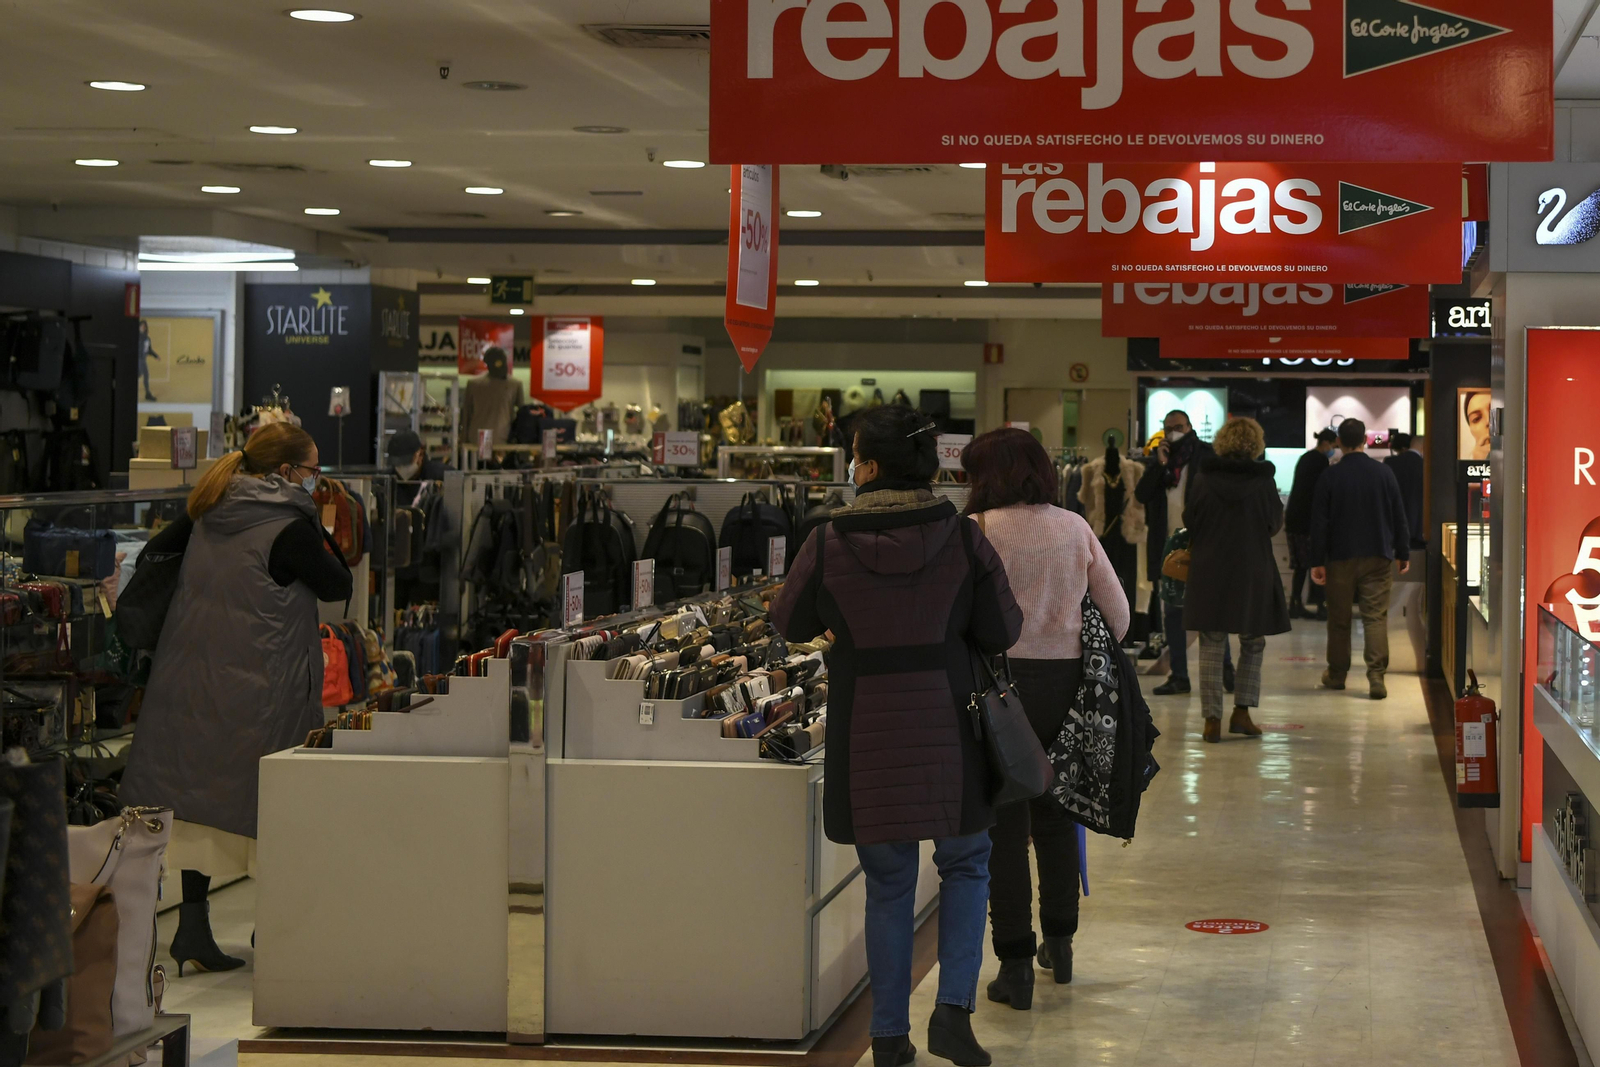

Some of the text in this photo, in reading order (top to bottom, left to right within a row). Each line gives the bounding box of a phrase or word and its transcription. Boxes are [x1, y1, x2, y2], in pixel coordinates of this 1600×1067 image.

[1351, 15, 1469, 44] El Corte Inglés
[747, 0, 1314, 110] rebajas
[941, 134, 1325, 146] SI NO QUEDA SATISFECHO LE DEVOLVEMOS SU DINERO
[1001, 162, 1323, 251] rebajas
[1343, 199, 1410, 215] El Corte Inglés
[741, 209, 768, 254] -50%
[1111, 264, 1328, 272] SI NO QUEDA SATISFECHO LE DEVOLVEMOS SU DINERO
[266, 305, 348, 335] STARLITE
[285, 335, 330, 344] UNIVERSE
[549, 362, 586, 377] -50%
[667, 444, 696, 456] -30%
